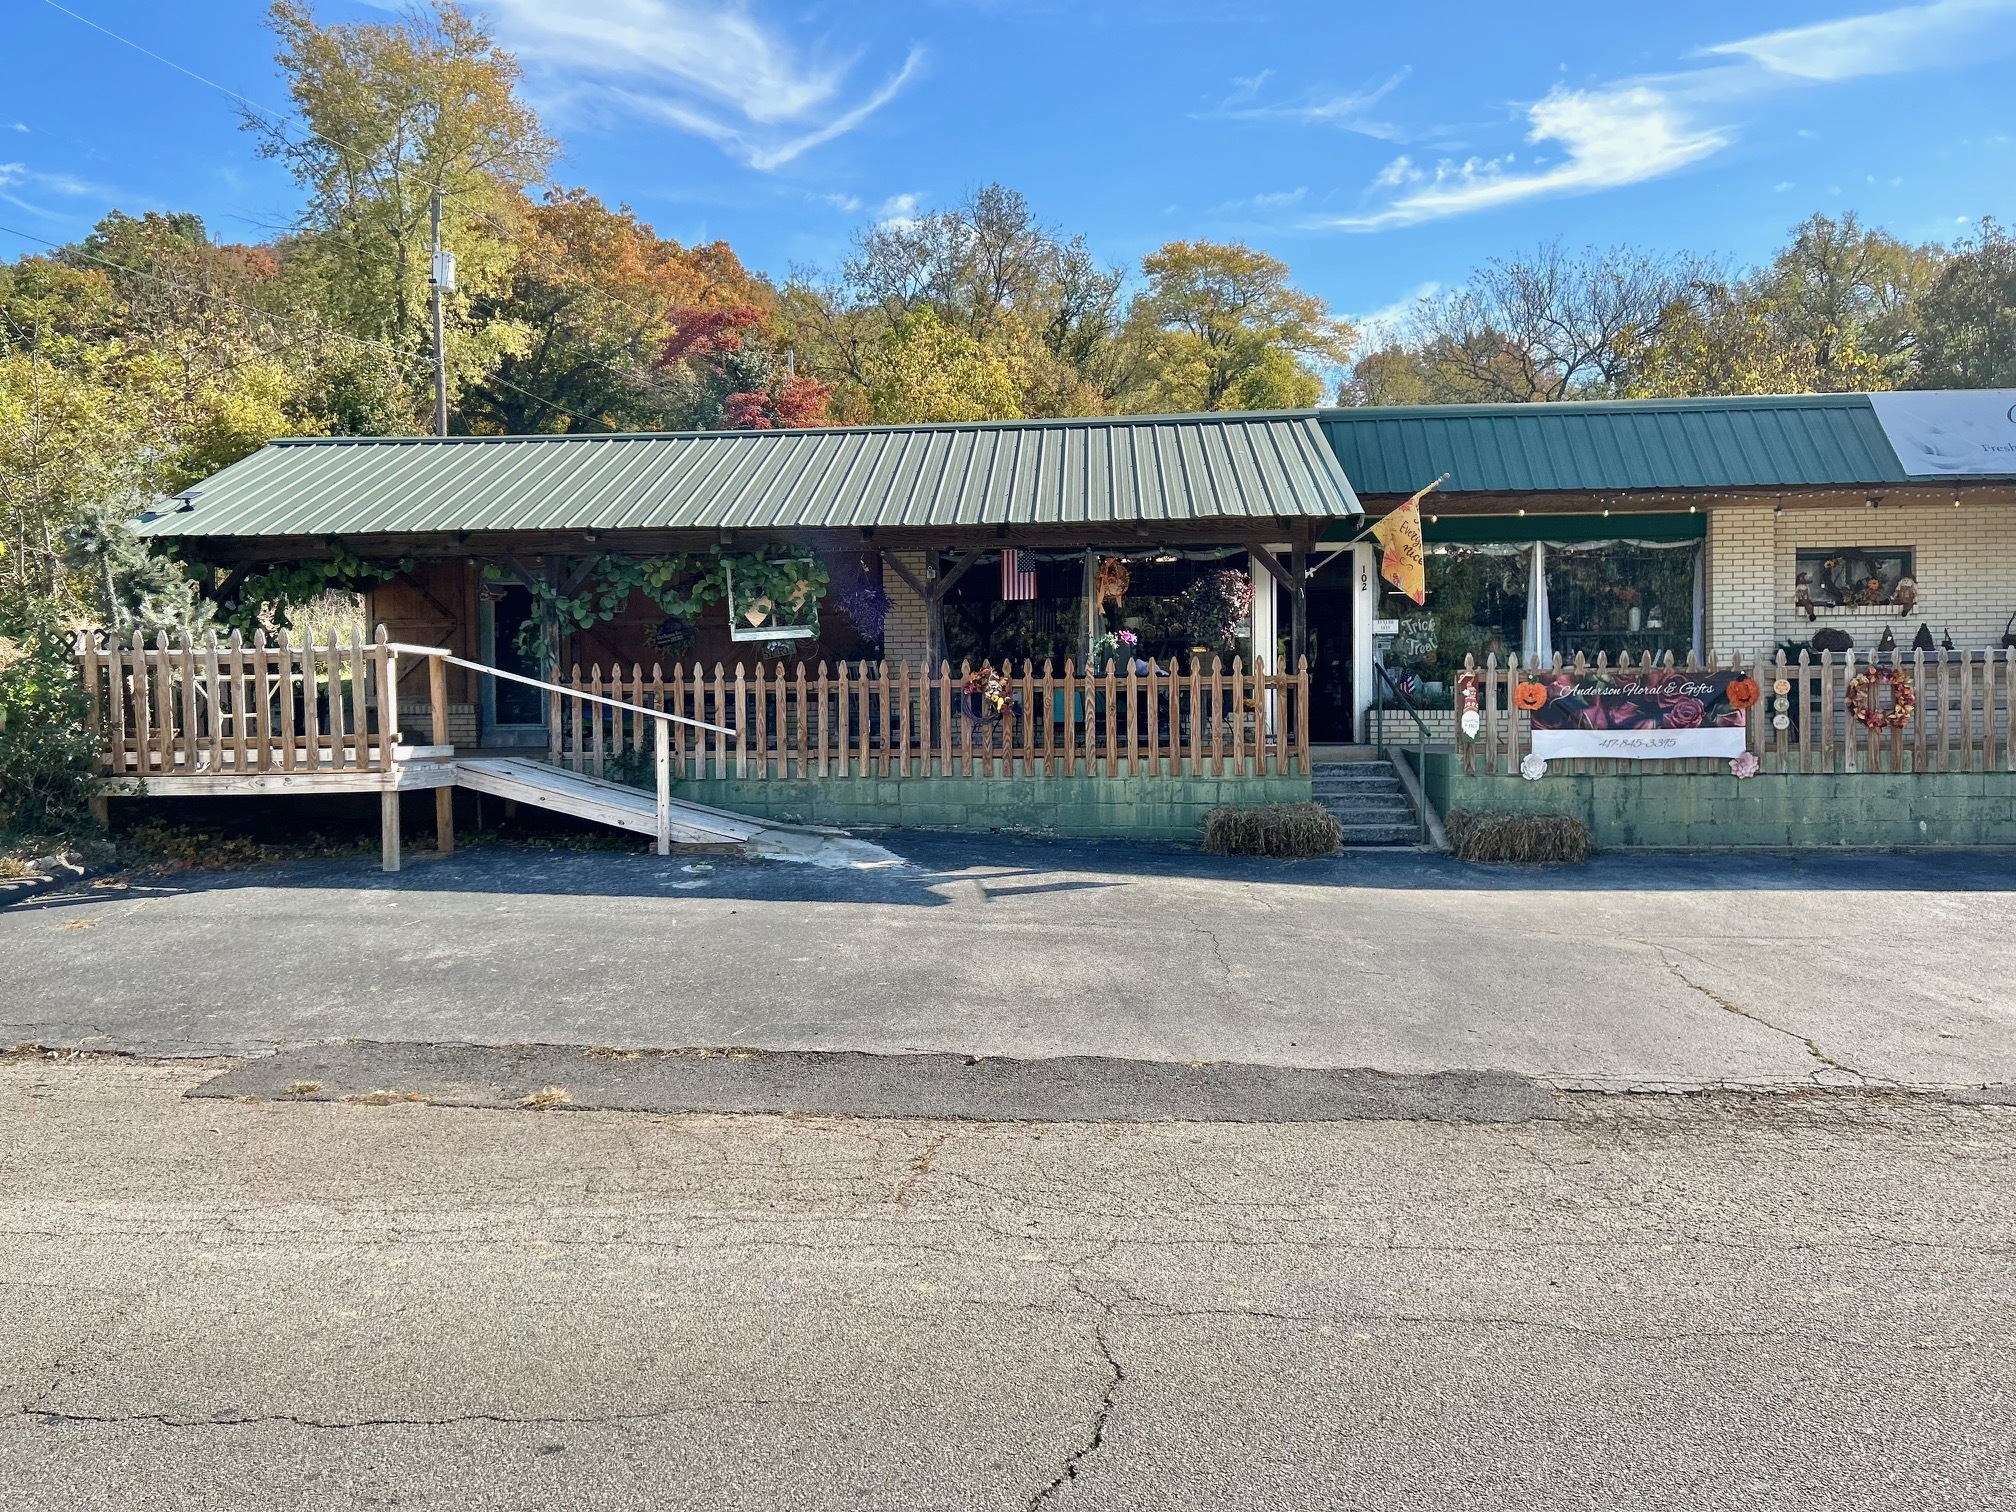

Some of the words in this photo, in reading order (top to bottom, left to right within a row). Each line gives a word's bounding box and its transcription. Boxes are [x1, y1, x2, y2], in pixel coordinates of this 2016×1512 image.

[1402, 544, 1423, 566] nice
[1401, 618, 1435, 635] Trick
[1550, 683, 1621, 704] Anderson
[1622, 682, 1663, 697] Floral
[1664, 681, 1678, 694] &
[1679, 681, 1715, 697] Gifts
[1598, 737, 1678, 749] 417-845-3395
